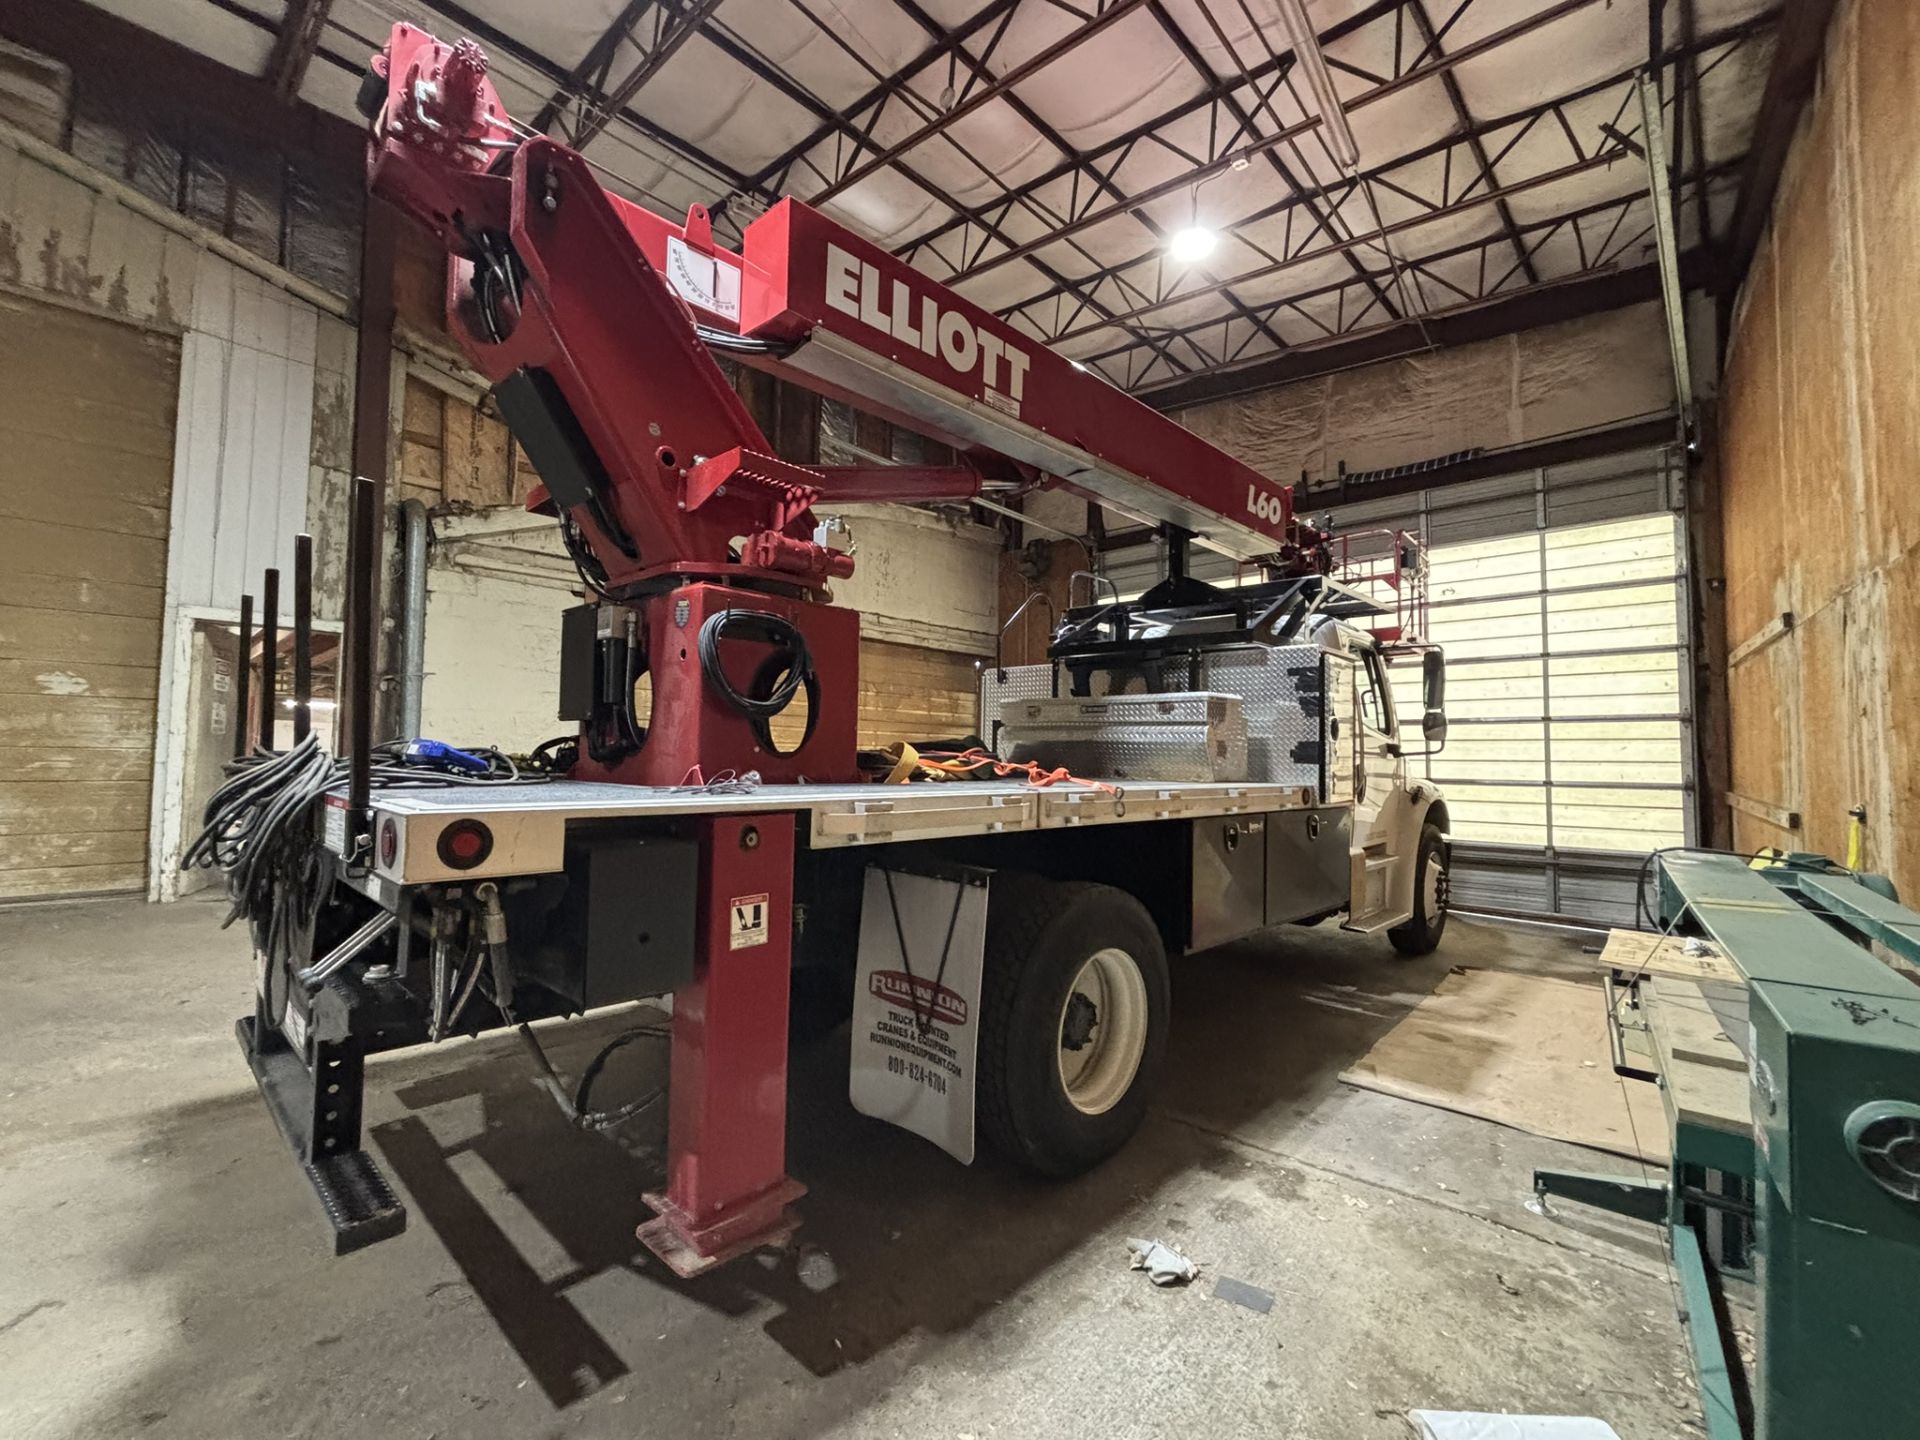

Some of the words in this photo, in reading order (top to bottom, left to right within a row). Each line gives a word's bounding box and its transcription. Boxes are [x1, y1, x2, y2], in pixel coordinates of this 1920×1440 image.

[825, 241, 1030, 401] ELLIOTT
[1247, 484, 1281, 525] L60
[870, 973, 966, 1018] RUNNON
[877, 1021, 908, 1038] CRANES
[910, 1030, 916, 1041] &
[918, 1032, 957, 1060] EQUIPMENT
[888, 1011, 914, 1027] TRUCK
[915, 1017, 949, 1041] UNTED
[869, 1032, 962, 1079] RUNNIONEQUIPMENT.COM
[888, 1055, 947, 1095] 800-824-6704
